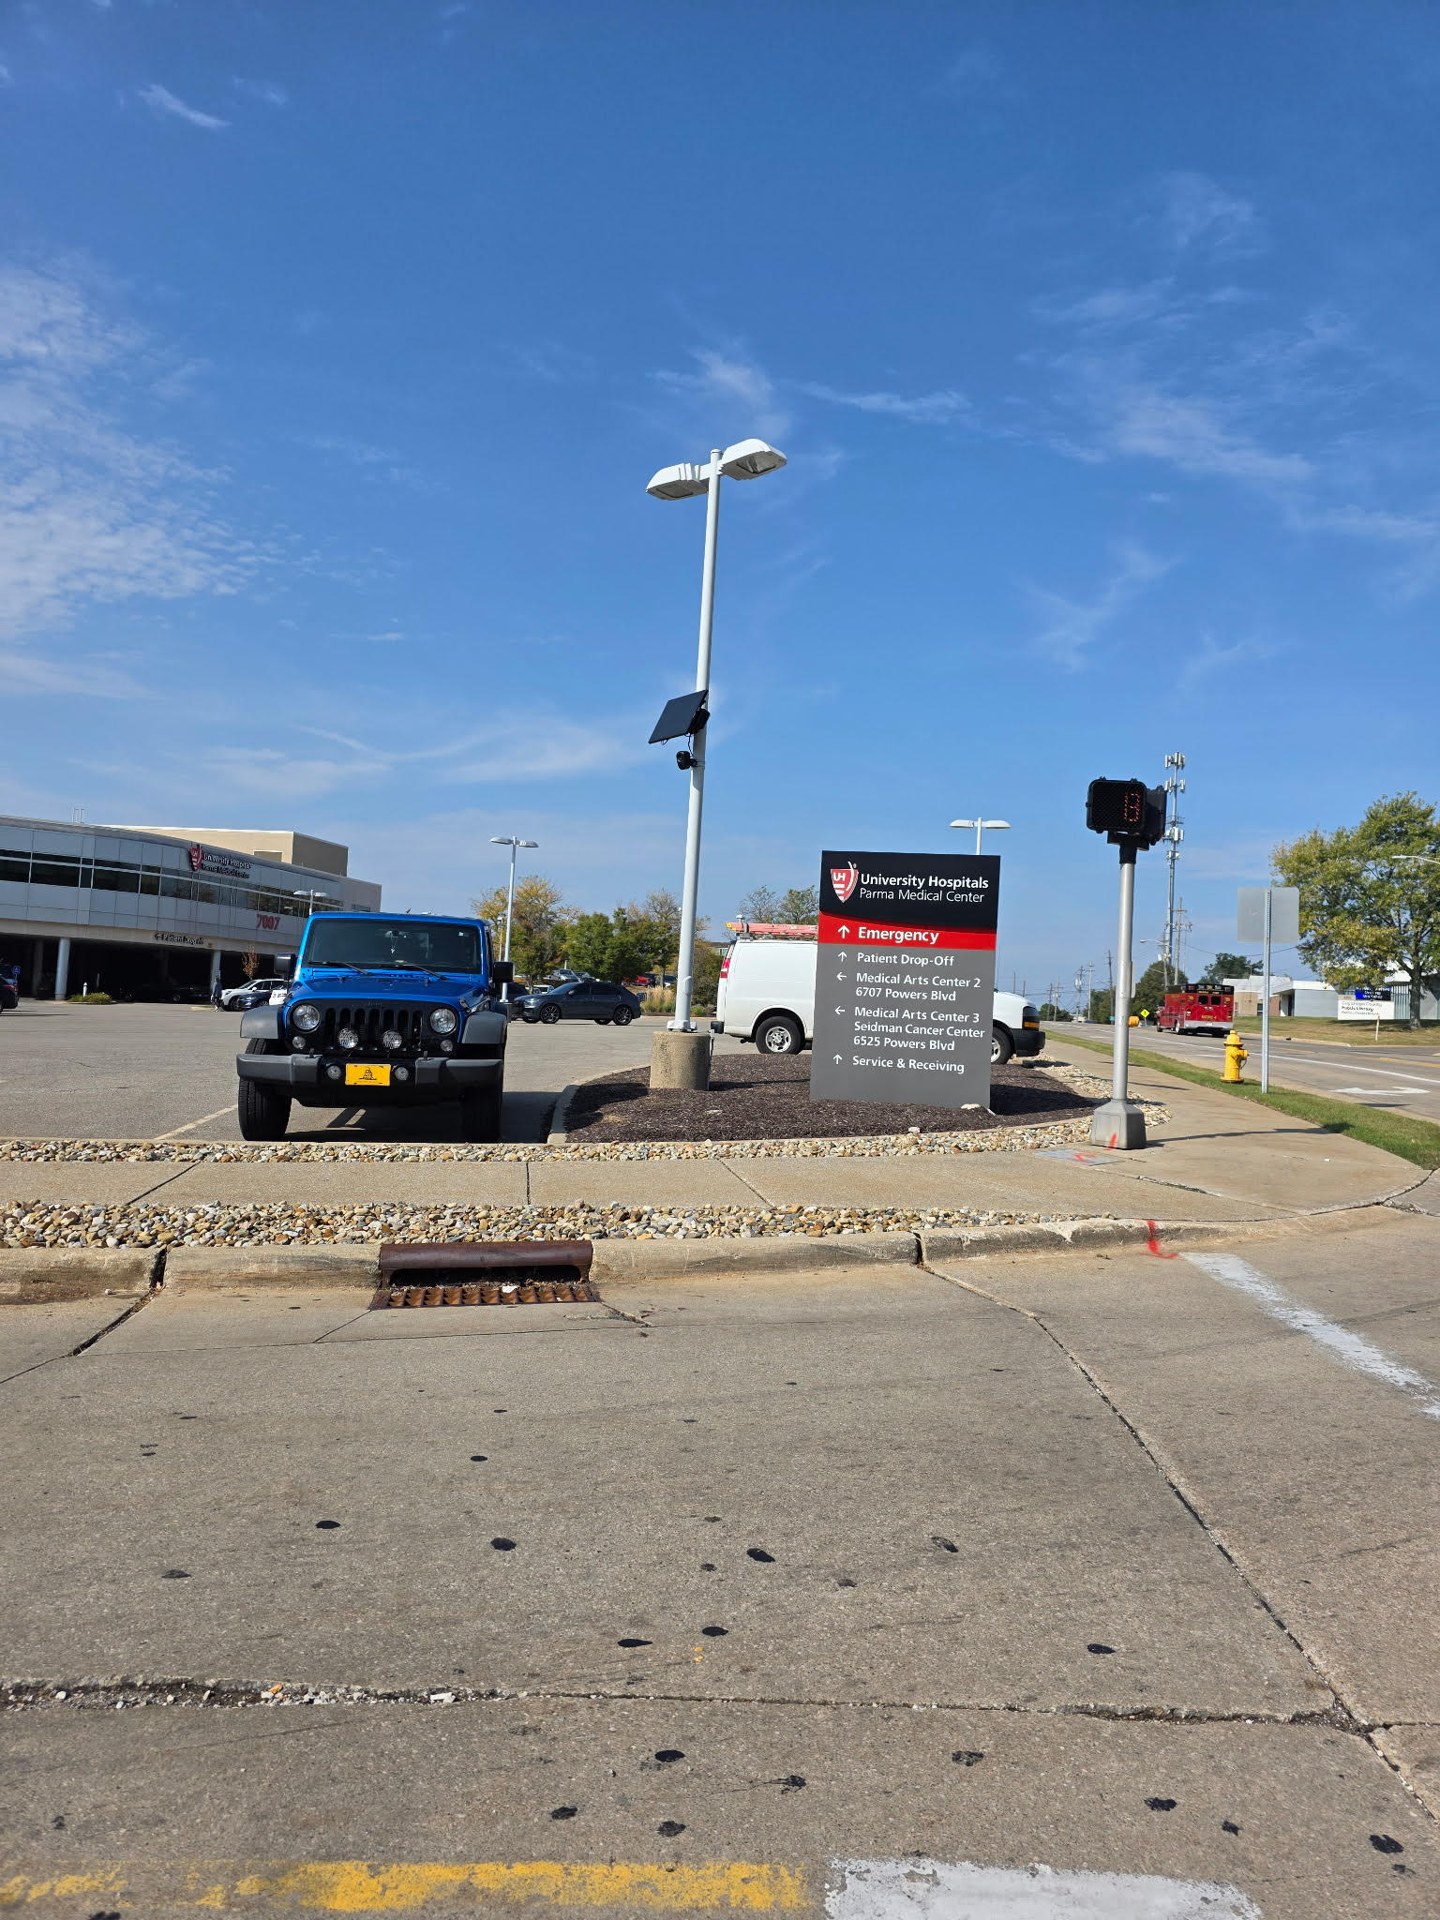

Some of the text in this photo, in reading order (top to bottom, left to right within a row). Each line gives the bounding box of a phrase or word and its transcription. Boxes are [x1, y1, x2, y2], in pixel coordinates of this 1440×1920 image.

[832, 872, 846, 881] UH
[860, 873, 989, 890] University Hospitals
[859, 888, 985, 903] Parma Medical Center
[858, 926, 939, 944] Emergency
[857, 952, 955, 967] Patient Drop-Off
[856, 973, 981, 988] Medical Arts Center 2
[856, 987, 956, 1001] 6707 Powers Blvd
[854, 1006, 980, 1023] Medical Arts Center 3
[854, 1021, 986, 1038] Seidman Cancer Center
[853, 1036, 955, 1051] 6525 Powers Blvd
[852, 1055, 965, 1074] Service & Receiving
